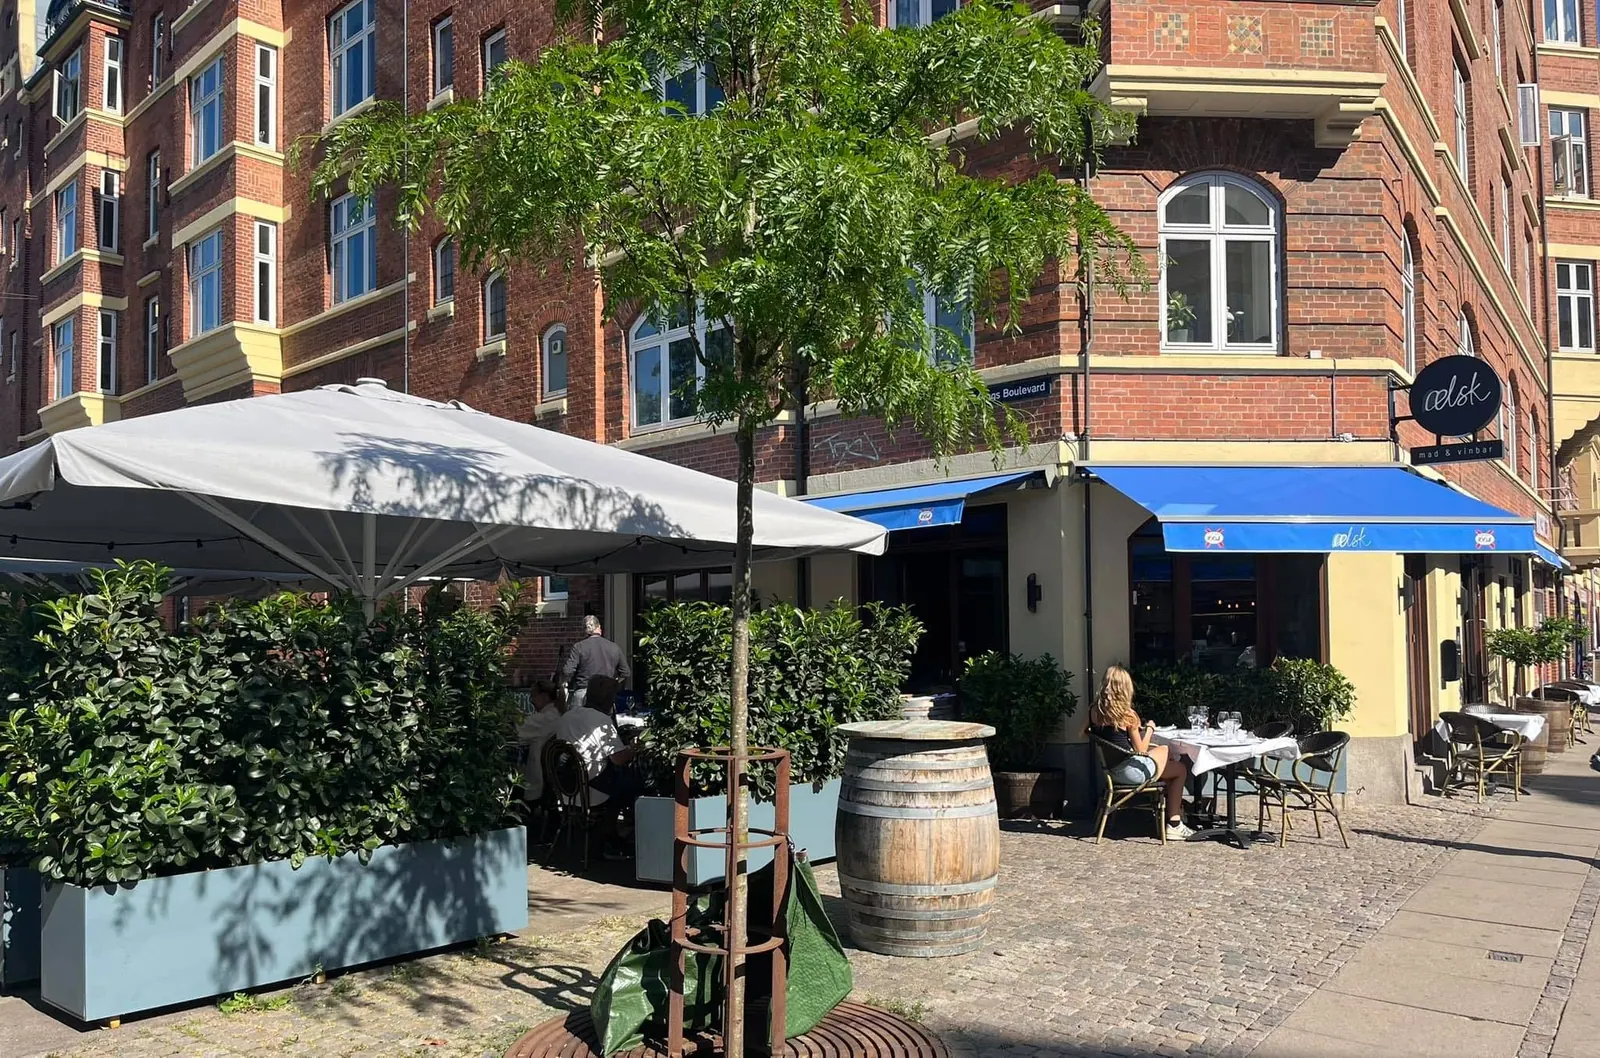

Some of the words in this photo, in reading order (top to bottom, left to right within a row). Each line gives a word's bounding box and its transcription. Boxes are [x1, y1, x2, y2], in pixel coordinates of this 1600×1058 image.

[1003, 382, 1045, 397] Boulevard
[1424, 371, 1492, 412] ælsk
[1419, 451, 1439, 459] mad
[1445, 448, 1451, 457] &
[1457, 447, 1492, 455] vinbar
